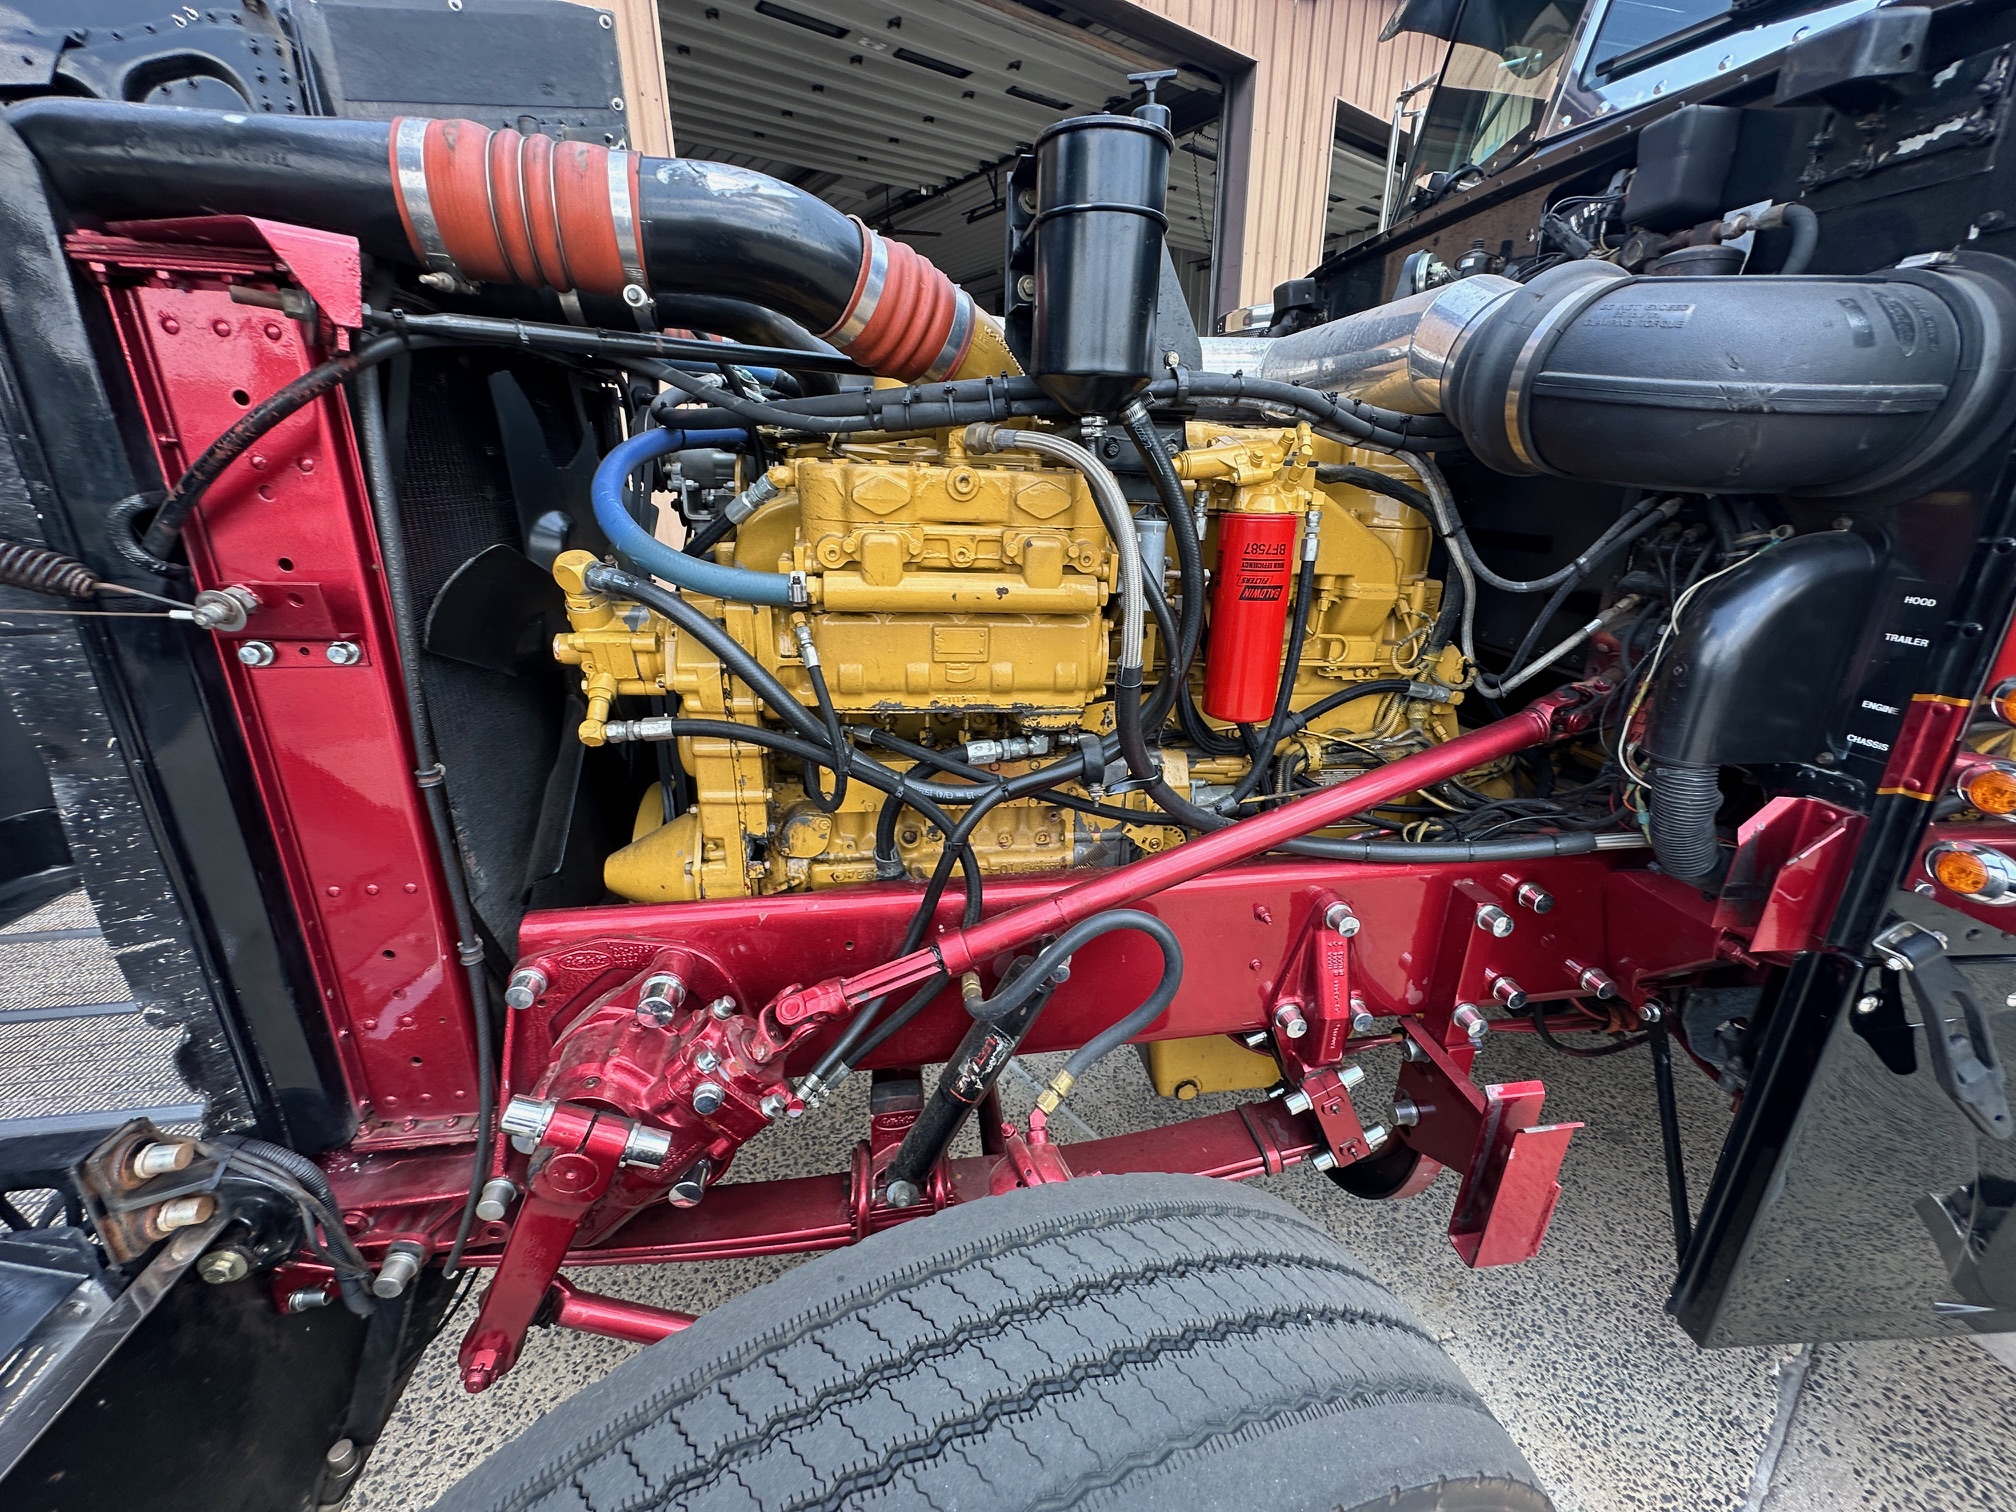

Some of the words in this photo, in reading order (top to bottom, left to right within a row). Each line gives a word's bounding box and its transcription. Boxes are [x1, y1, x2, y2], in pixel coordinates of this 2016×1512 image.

[1243, 542, 1287, 556] BF7587
[1240, 561, 1273, 570] EFFICIENCY
[1240, 577, 1270, 586] FILTERS
[1242, 588, 1282, 600] BALDWIN
[1904, 596, 1937, 607] HOOD
[1884, 632, 1930, 648] TRAILER
[1862, 700, 1902, 716] ENGINE
[1846, 733, 1890, 752] CHASSIS
